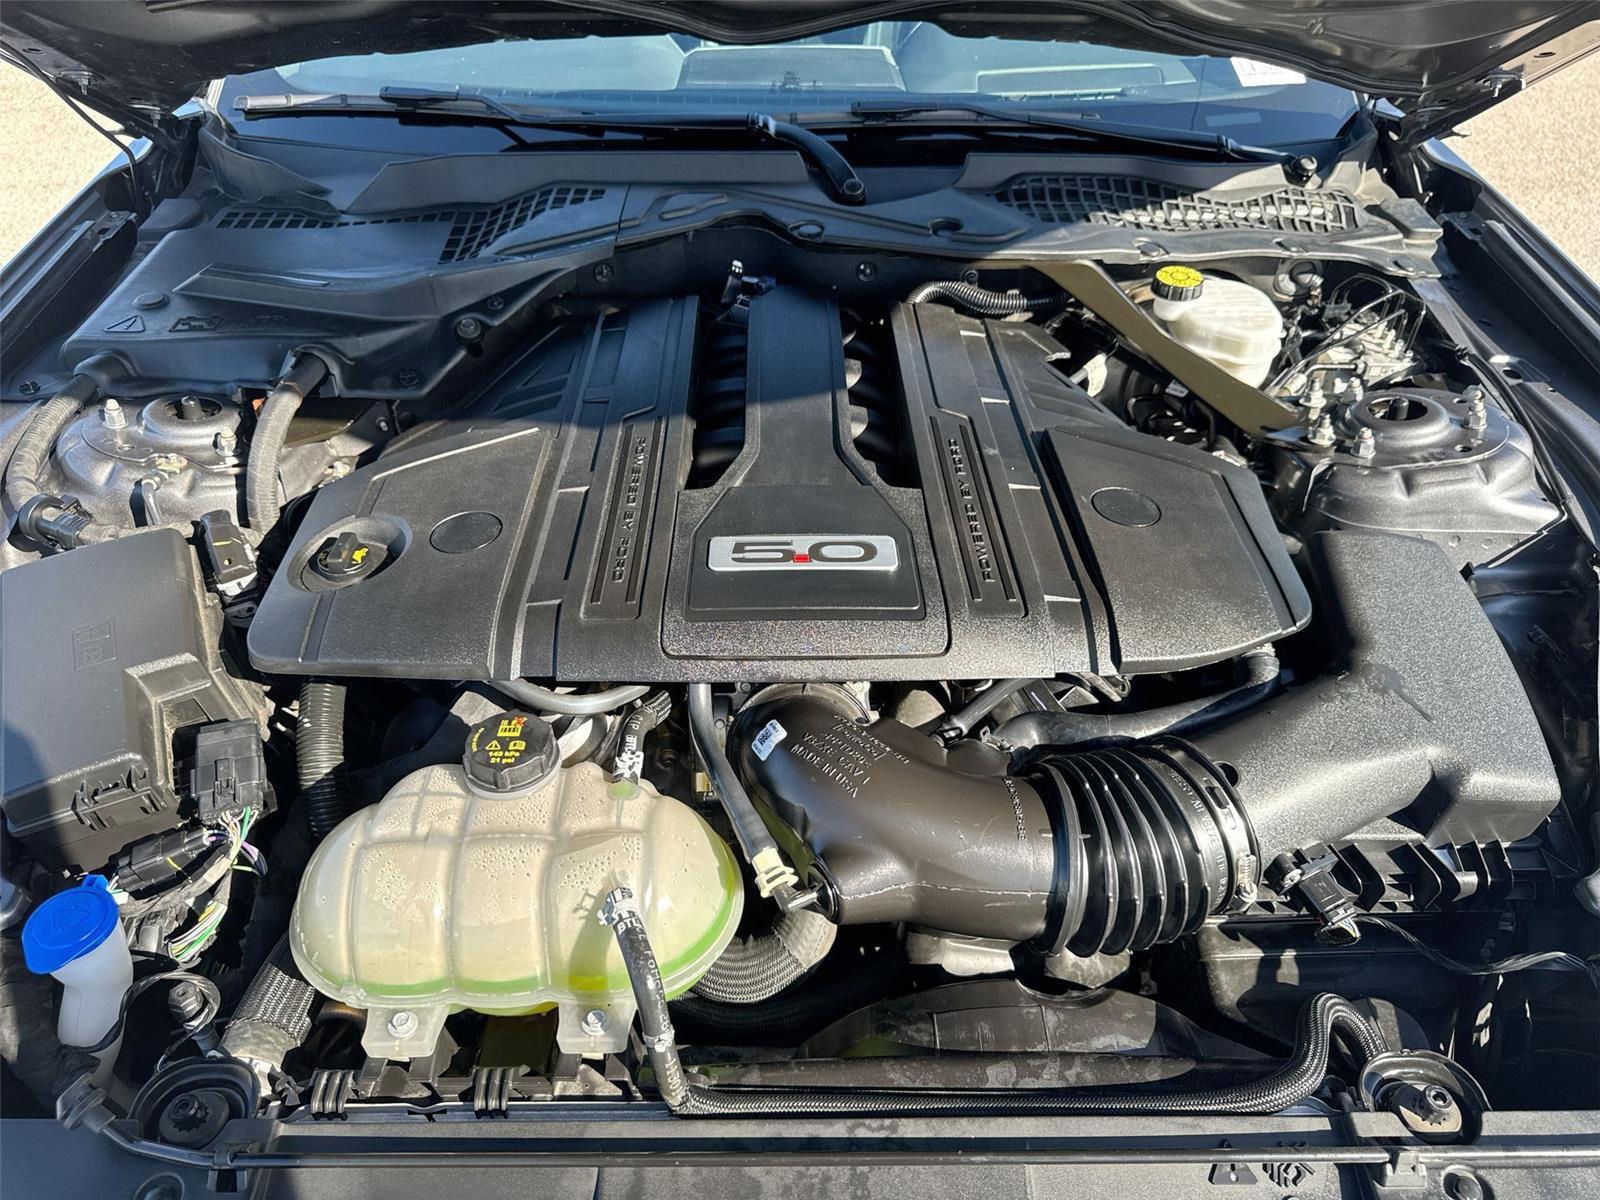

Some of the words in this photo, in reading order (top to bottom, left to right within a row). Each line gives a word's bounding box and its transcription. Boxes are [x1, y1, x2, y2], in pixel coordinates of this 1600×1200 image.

[626, 437, 646, 505] POWERED
[948, 438, 966, 475] FORD
[958, 479, 972, 499] BY
[623, 511, 635, 532] BY
[612, 537, 630, 583] FORD
[731, 541, 878, 563] 5.0
[965, 504, 995, 583] POWERED
[790, 744, 825, 768] MADE
[821, 763, 837, 777] IN
[835, 773, 858, 798] USA
